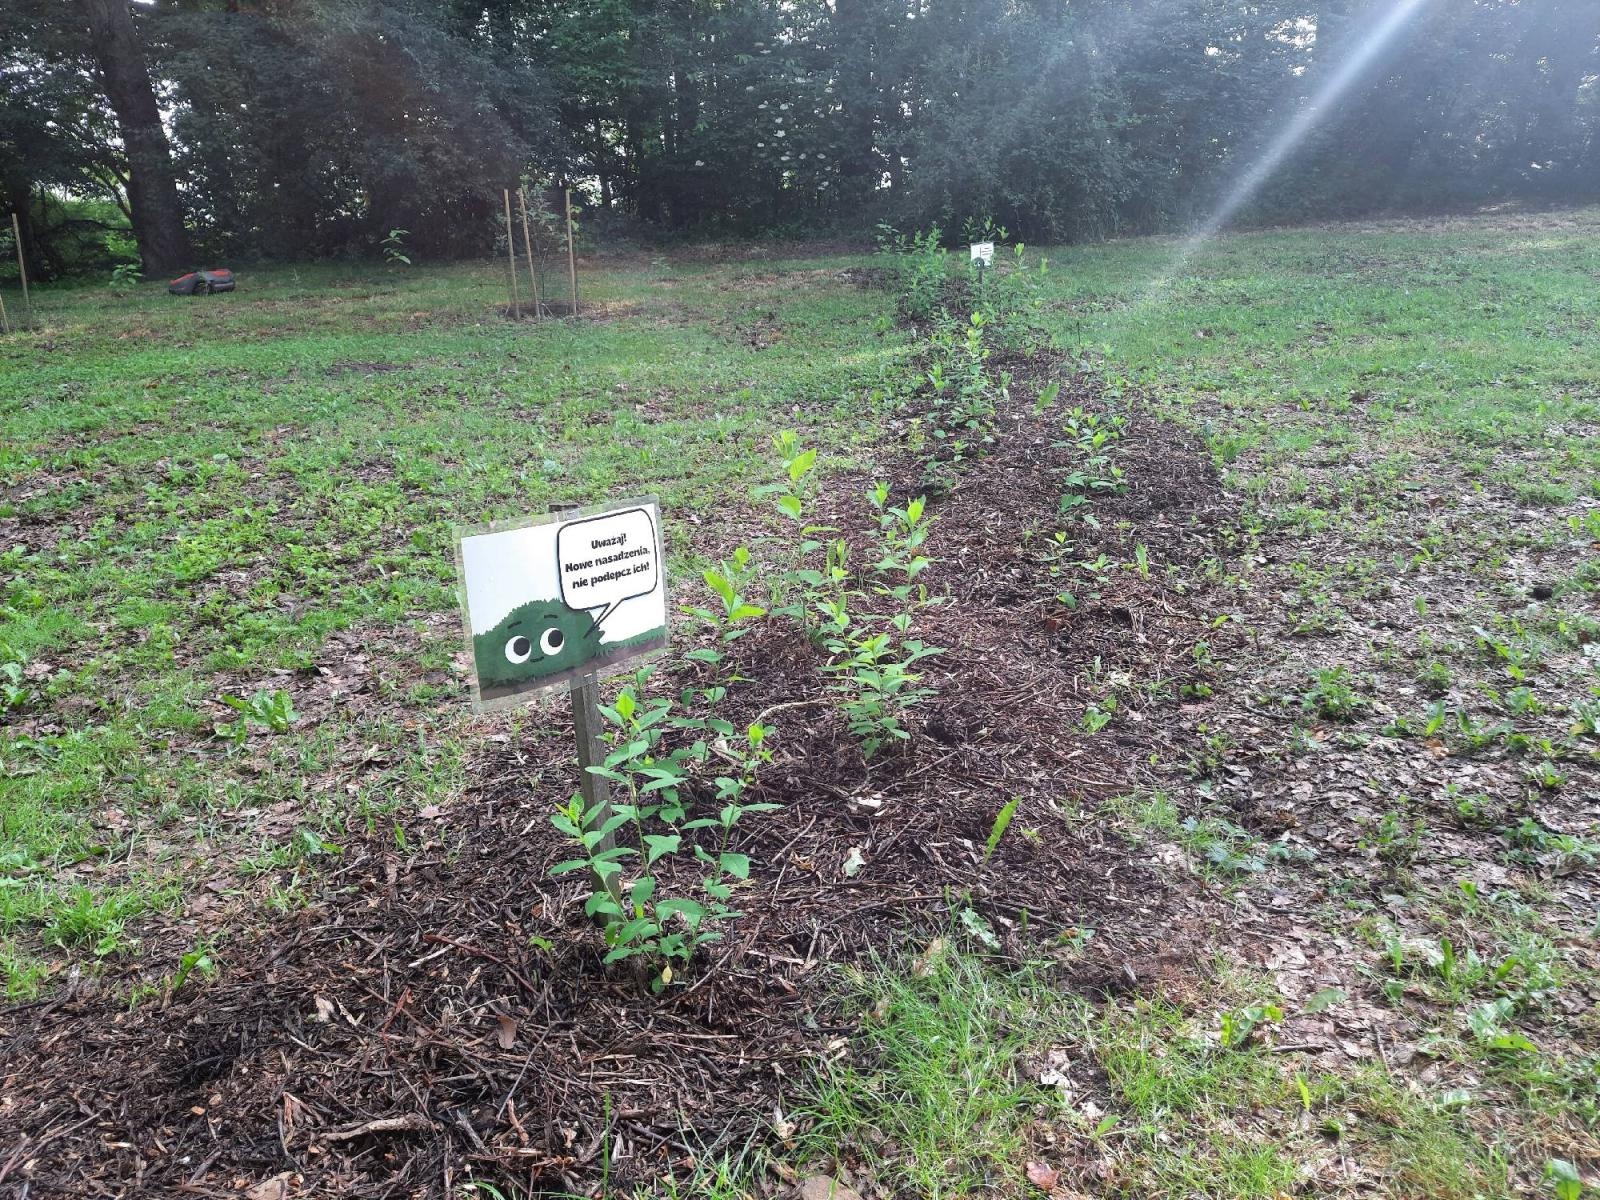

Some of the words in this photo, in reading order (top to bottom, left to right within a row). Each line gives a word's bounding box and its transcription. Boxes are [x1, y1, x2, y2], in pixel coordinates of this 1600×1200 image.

[591, 533, 627, 549] Uważaj!
[565, 560, 593, 573] Nowe
[572, 577, 589, 589] nie
[590, 568, 632, 587] podepcz
[633, 561, 650, 574] ich!
